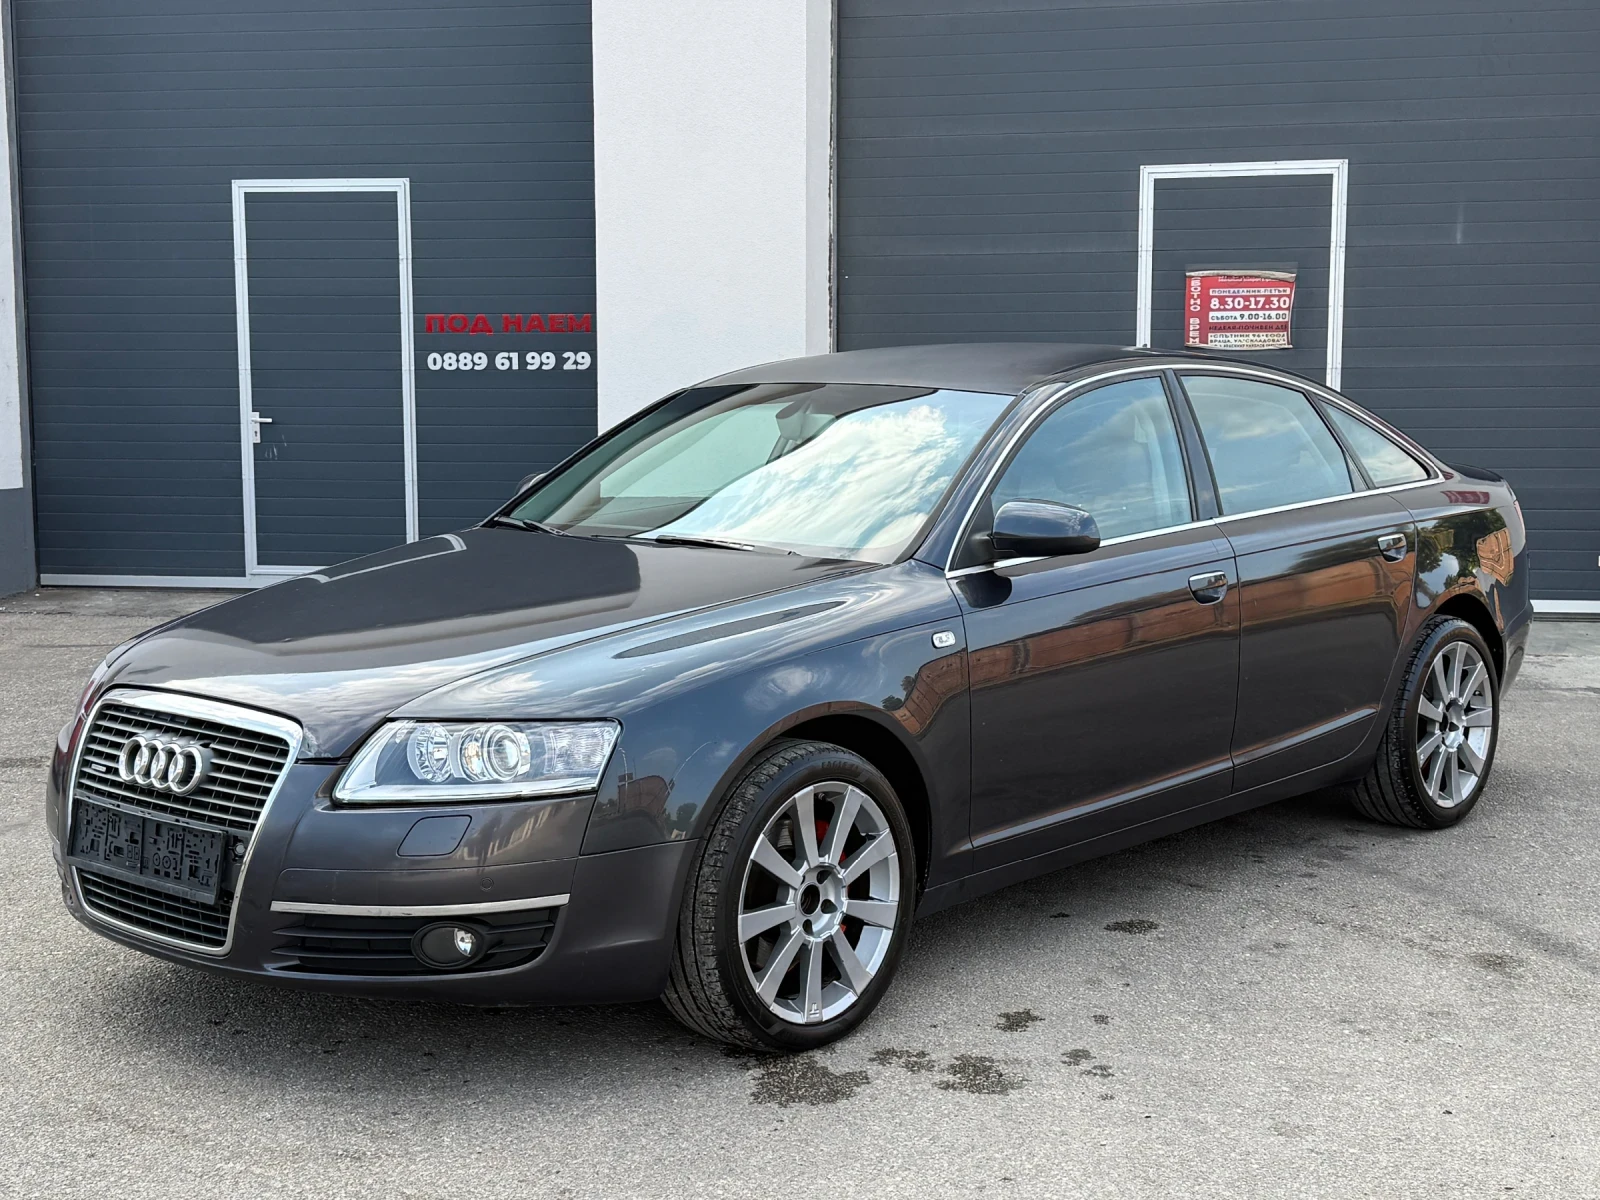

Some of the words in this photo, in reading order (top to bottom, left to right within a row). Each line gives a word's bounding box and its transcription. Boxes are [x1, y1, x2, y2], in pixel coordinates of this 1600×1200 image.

[1190, 277, 1202, 311] БОТНО
[1210, 297, 1290, 309] 8.30-17.30
[425, 314, 493, 335] ПОД
[502, 314, 592, 333] НАЕМ
[427, 352, 488, 371] 0889
[495, 352, 519, 371] 61
[525, 351, 556, 371] 99
[562, 351, 592, 371] 29
